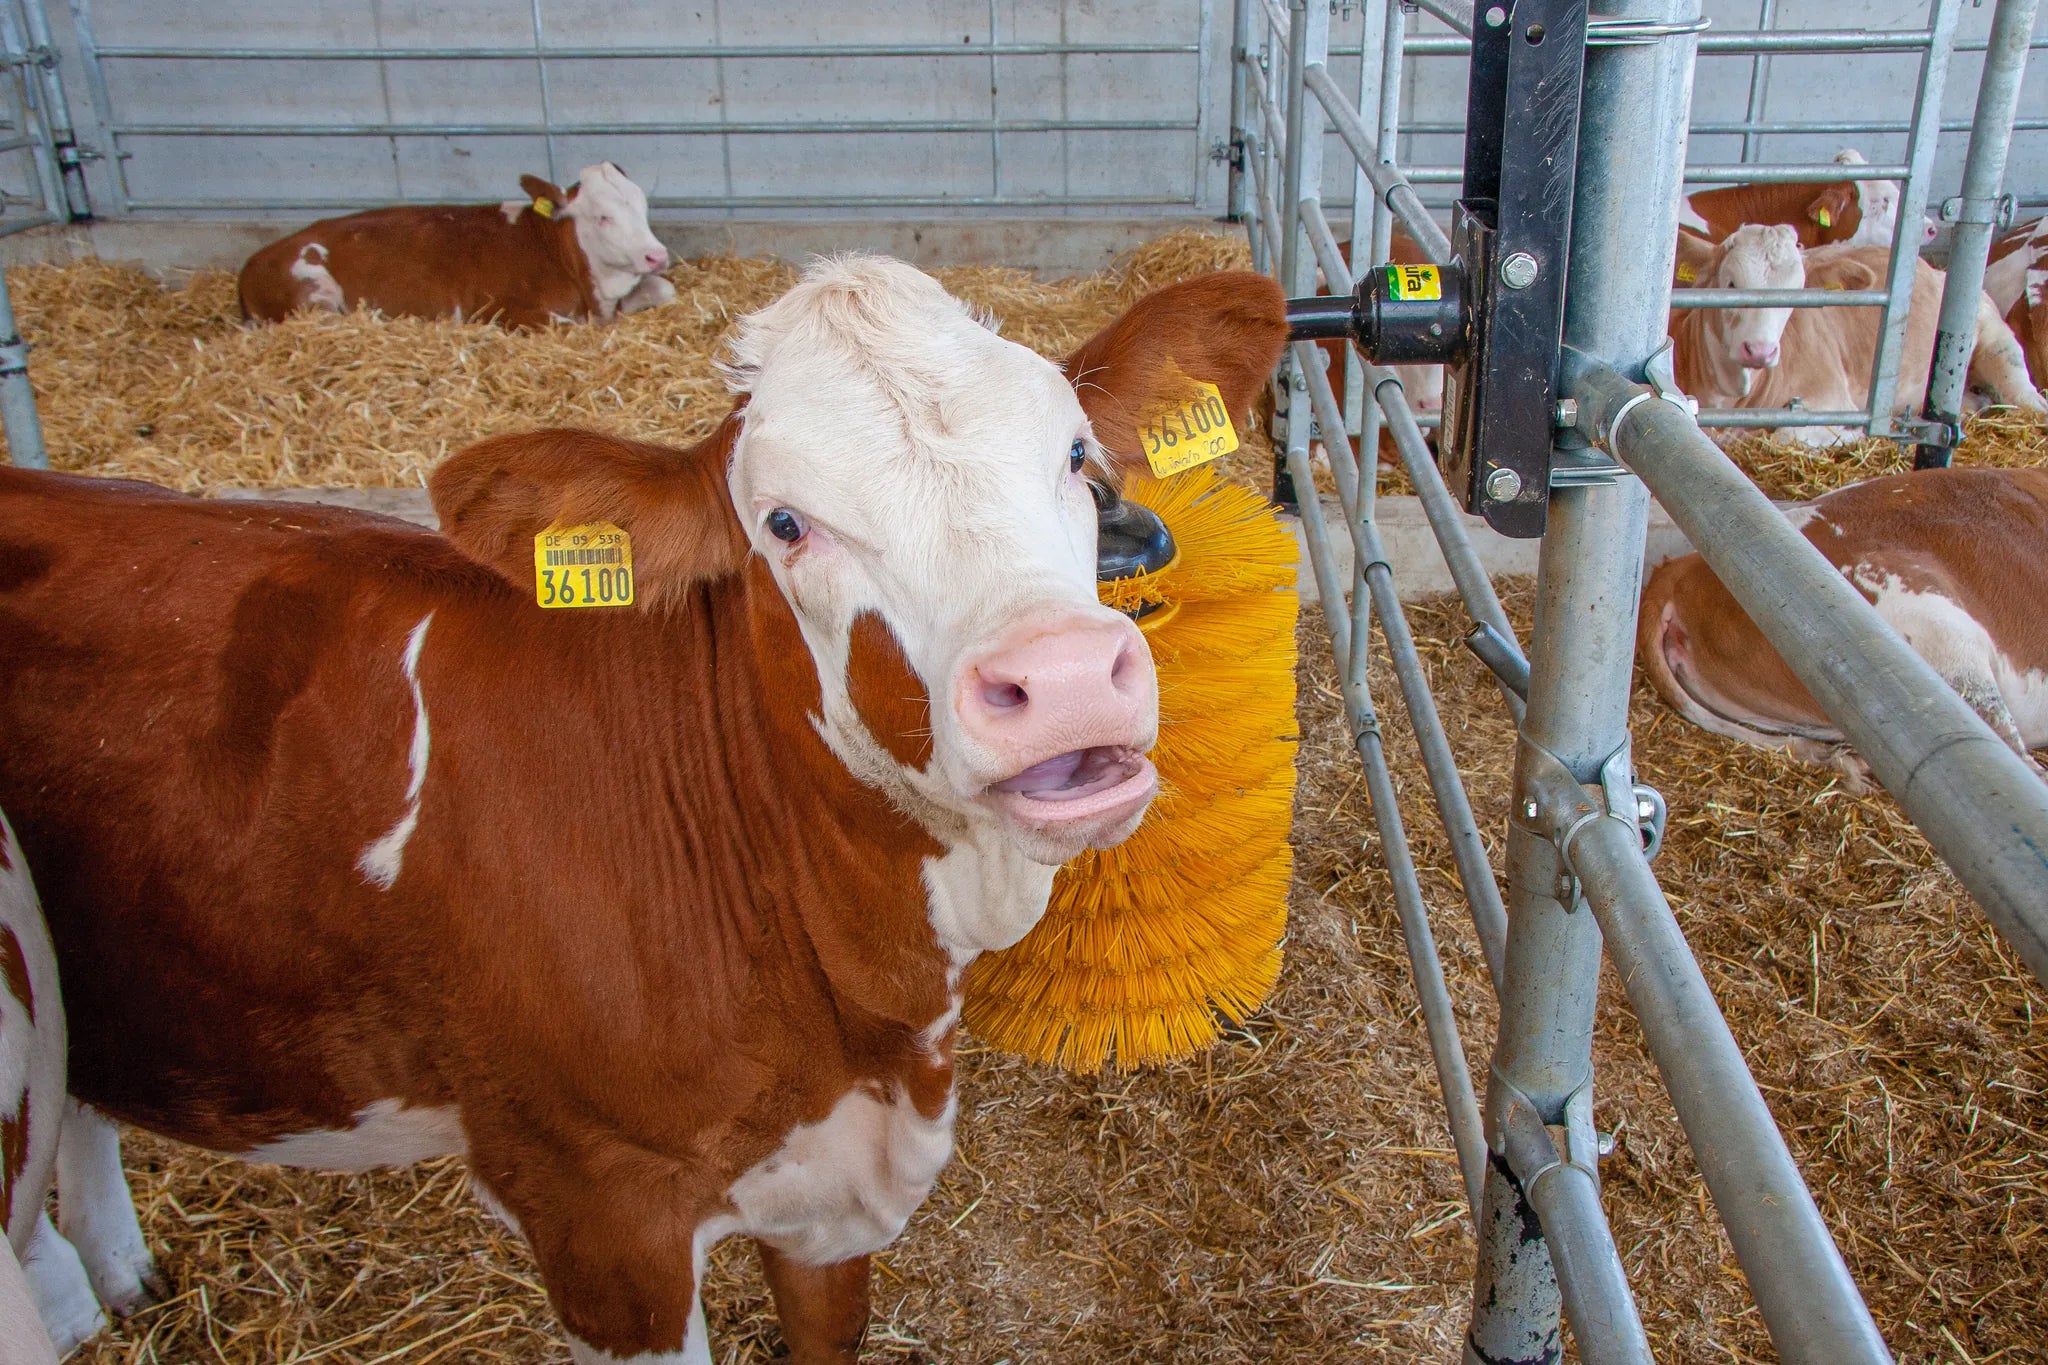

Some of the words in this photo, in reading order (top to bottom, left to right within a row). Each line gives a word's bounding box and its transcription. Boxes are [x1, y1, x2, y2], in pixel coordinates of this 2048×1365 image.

[545, 535, 561, 546] DE
[572, 535, 588, 545] 09
[599, 534, 621, 544] 538
[542, 567, 630, 605] 36100
